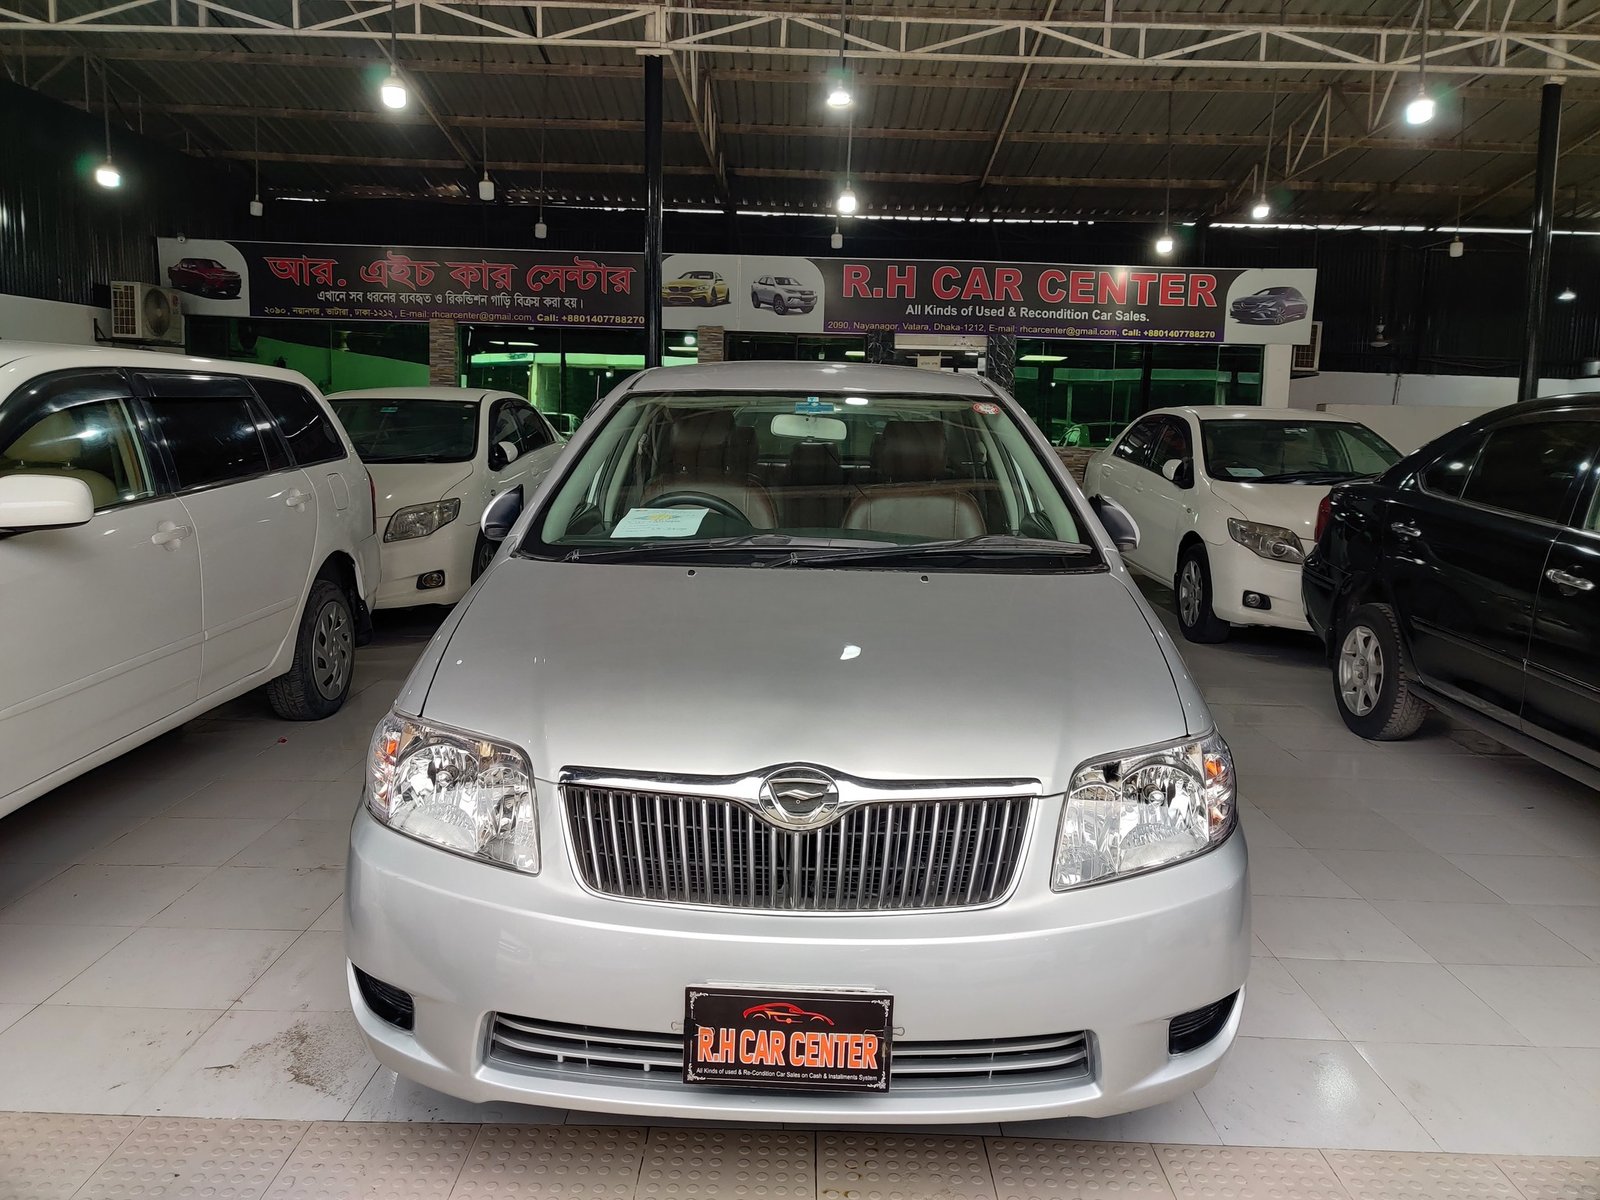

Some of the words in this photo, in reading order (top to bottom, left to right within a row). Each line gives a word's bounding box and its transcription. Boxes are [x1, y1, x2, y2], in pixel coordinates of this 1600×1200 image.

[263, 254, 346, 287] আর.
[360, 250, 440, 291] এইচ
[443, 259, 518, 291] কার
[526, 255, 637, 294] সেন্টার
[842, 264, 916, 299] R.H
[932, 265, 1024, 301] CAR
[1037, 268, 1217, 308] CENTER
[317, 290, 347, 303] এখানে
[348, 291, 364, 303] সব
[366, 291, 396, 303] ধরনের
[398, 292, 432, 306] ব্যবহৃত
[435, 293, 443, 303] ও
[490, 291, 512, 309] গাড়ি
[542, 295, 561, 308] করা
[400, 309, 430, 319] E-mail:
[536, 313, 559, 322] Call:
[561, 314, 645, 324] +8801407788270
[905, 304, 921, 315] All
[924, 304, 957, 316] Kinds
[960, 305, 974, 316] of
[975, 306, 1004, 317] Used
[1007, 306, 1016, 318] &
[1019, 306, 1089, 320] Recondition
[1092, 309, 1112, 321] Car
[1115, 309, 1150, 322] Sales.
[988, 323, 1017, 333] E-mail:
[1121, 328, 1141, 337] Call:
[697, 1026, 736, 1064] R.H
[739, 1028, 785, 1066] CAR
[789, 1031, 878, 1070] CENTER
[742, 1068, 775, 1077] Re-Condition
[786, 1071, 800, 1079] Sales
